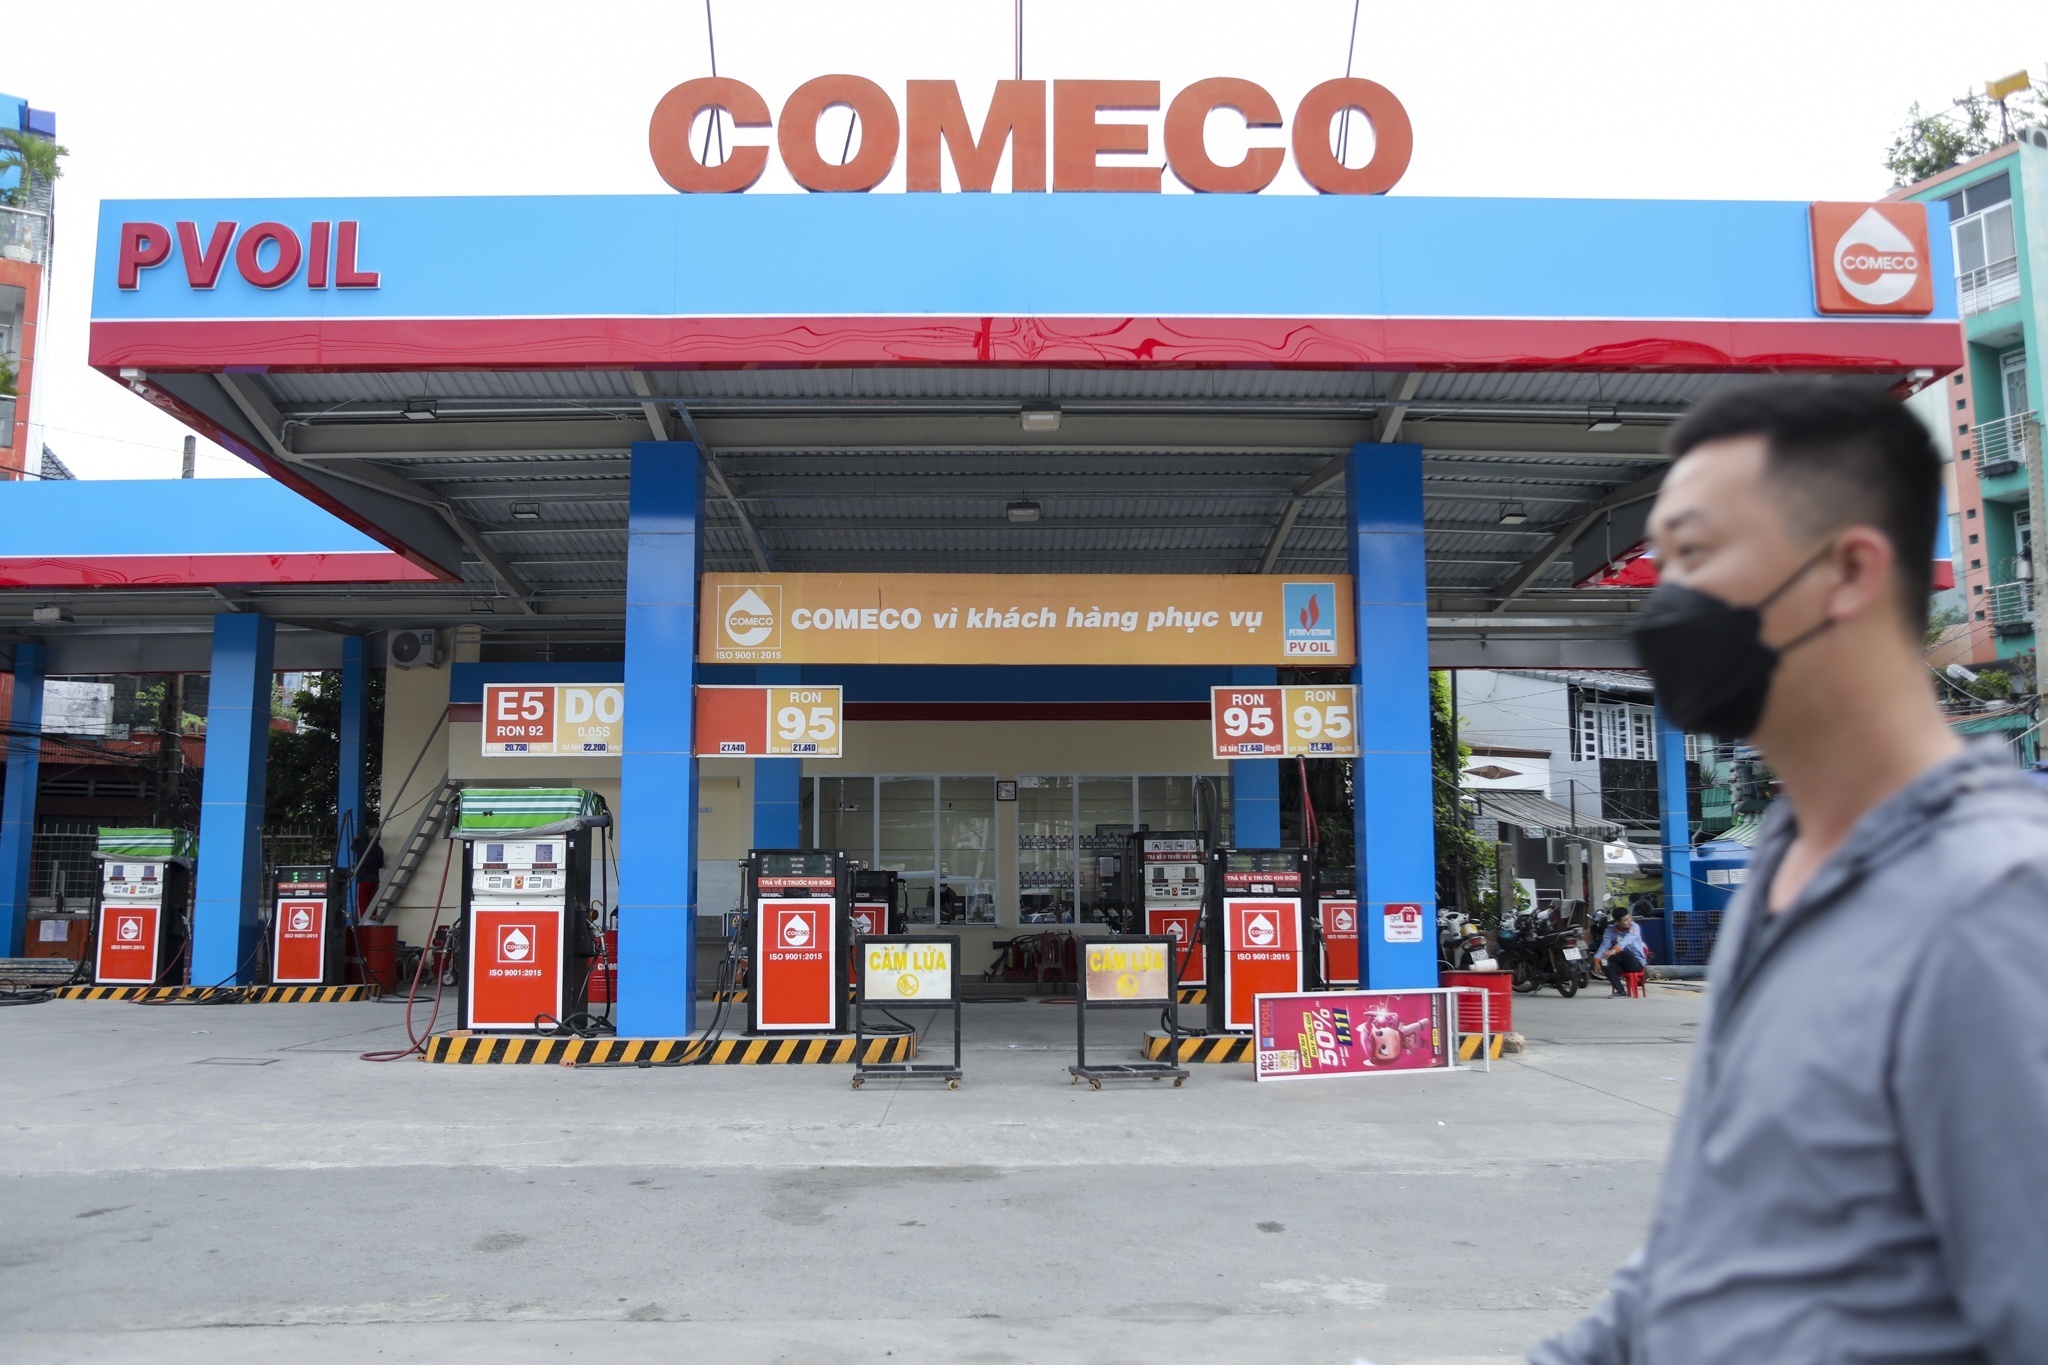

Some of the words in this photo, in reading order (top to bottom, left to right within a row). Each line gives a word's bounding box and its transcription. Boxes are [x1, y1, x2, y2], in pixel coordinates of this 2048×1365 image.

[648, 73, 1414, 194] COMECO
[116, 221, 381, 290] PVOIL
[1843, 256, 1918, 270] COMECO
[730, 616, 774, 626] COMECO
[791, 608, 922, 630] COMECO
[933, 608, 959, 629] vì
[966, 606, 1057, 629] khách
[1066, 606, 1139, 632] hàng
[1146, 606, 1219, 633] phục
[1229, 611, 1263, 633] vụ
[716, 651, 733, 660] ISO
[735, 651, 782, 660] 9001:2015
[497, 691, 544, 721] E5
[565, 688, 624, 723] DO
[790, 691, 822, 703] RON
[1232, 694, 1264, 706] RON
[1305, 690, 1336, 702] RON
[497, 725, 524, 737] RON
[528, 726, 543, 736] 92
[578, 726, 611, 738] 0,05S
[777, 706, 836, 741] 95
[1223, 707, 1274, 737] 95
[1293, 705, 1352, 739] 95
[583, 743, 606, 751] 22.200
[721, 744, 744, 752] 21.440
[762, 878, 773, 886] TRẢ
[868, 945, 907, 971] CẤM
[913, 945, 947, 971] LỬA
[1132, 945, 1164, 972] LỬA
[489, 969, 503, 977] ISO
[1261, 1001, 1271, 1036] PVOIL
[1333, 1013, 1352, 1042] 1.11
[1311, 1008, 1339, 1066] 50%
